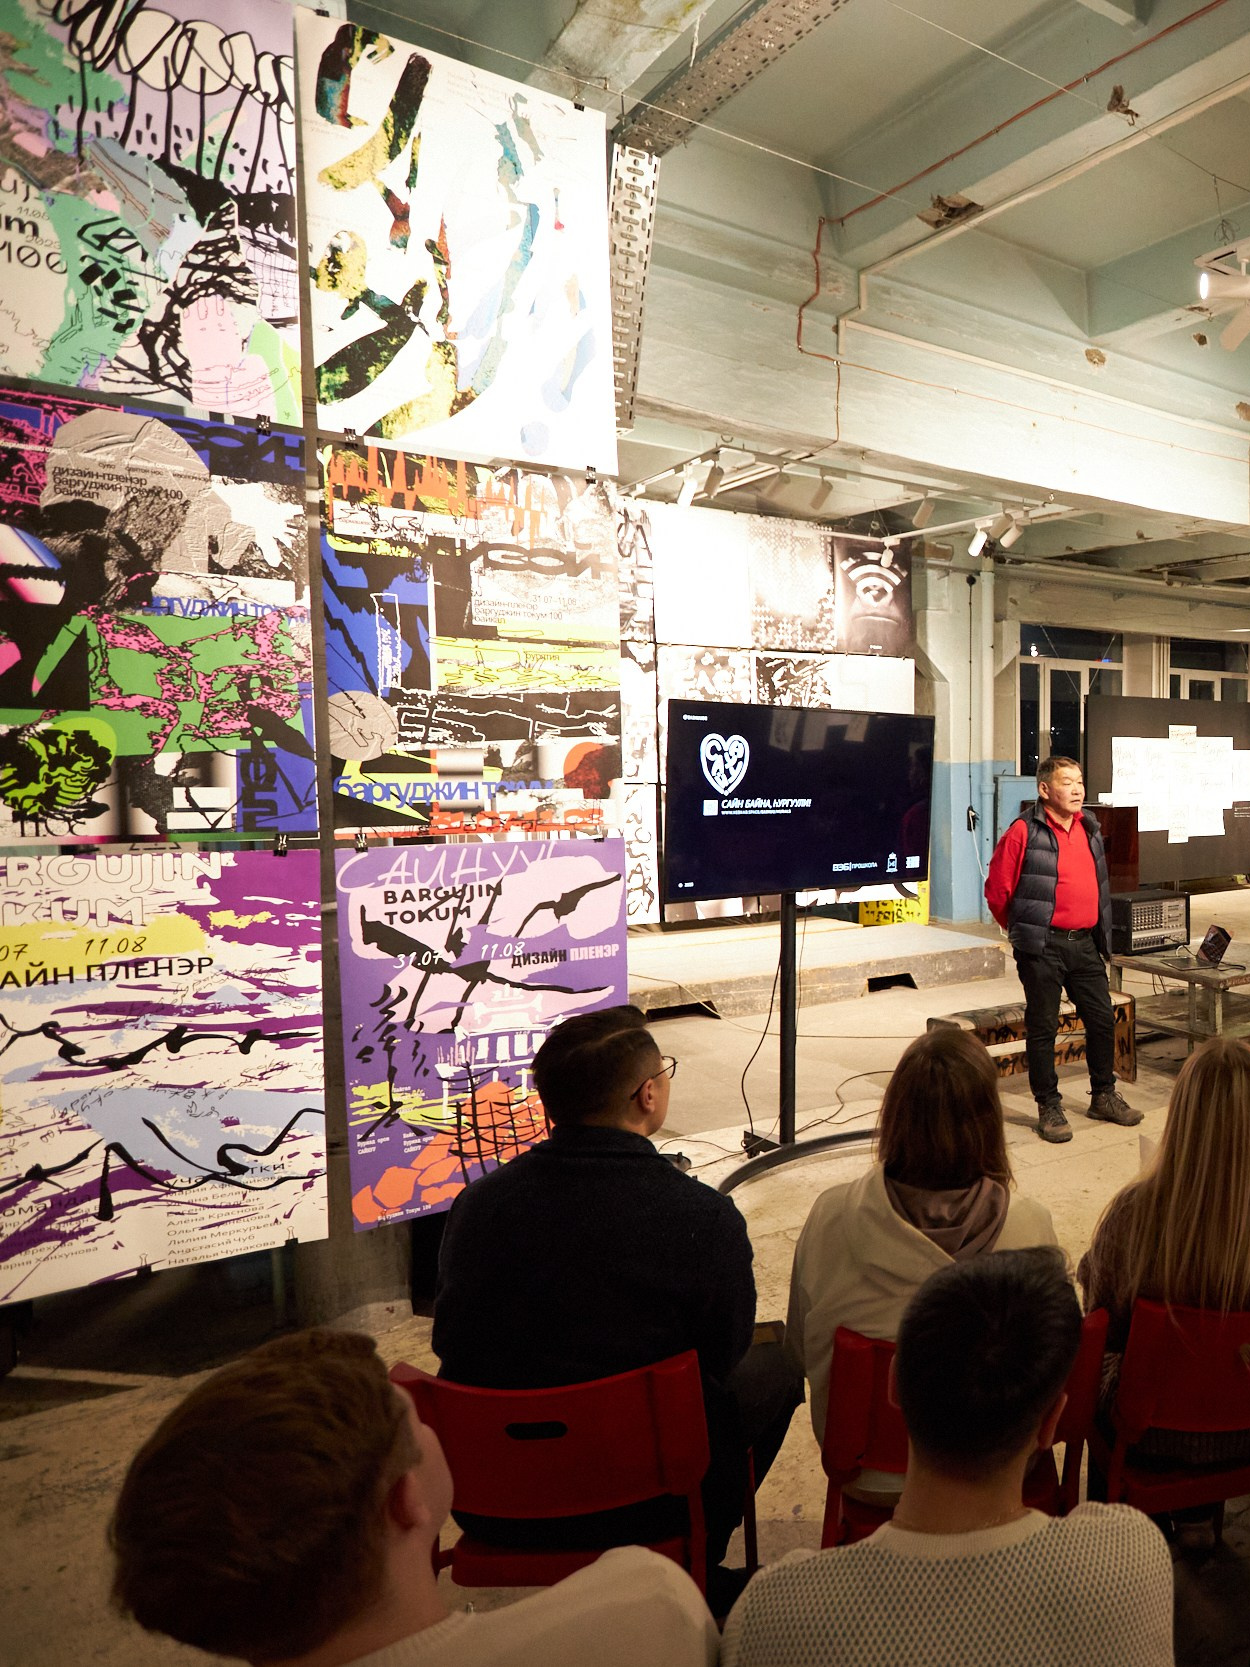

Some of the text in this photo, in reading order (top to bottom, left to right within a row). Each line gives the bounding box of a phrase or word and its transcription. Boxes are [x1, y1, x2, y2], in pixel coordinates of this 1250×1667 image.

[52, 466, 148, 486] дизайн-пленэр
[53, 475, 122, 493] баргуджин
[333, 775, 479, 809] баргуджин
[721, 798, 744, 809] САЙН
[5, 851, 222, 893] RGUJIN
[383, 883, 503, 905] BARGUJIN
[384, 905, 472, 926] TOKUM
[85, 936, 147, 956] 11.08
[393, 941, 526, 969] 31.07 11.08
[511, 943, 620, 968] ДИЗАЙН ПЛЕНЭР
[86, 957, 214, 984] ПЛЕНЭР
